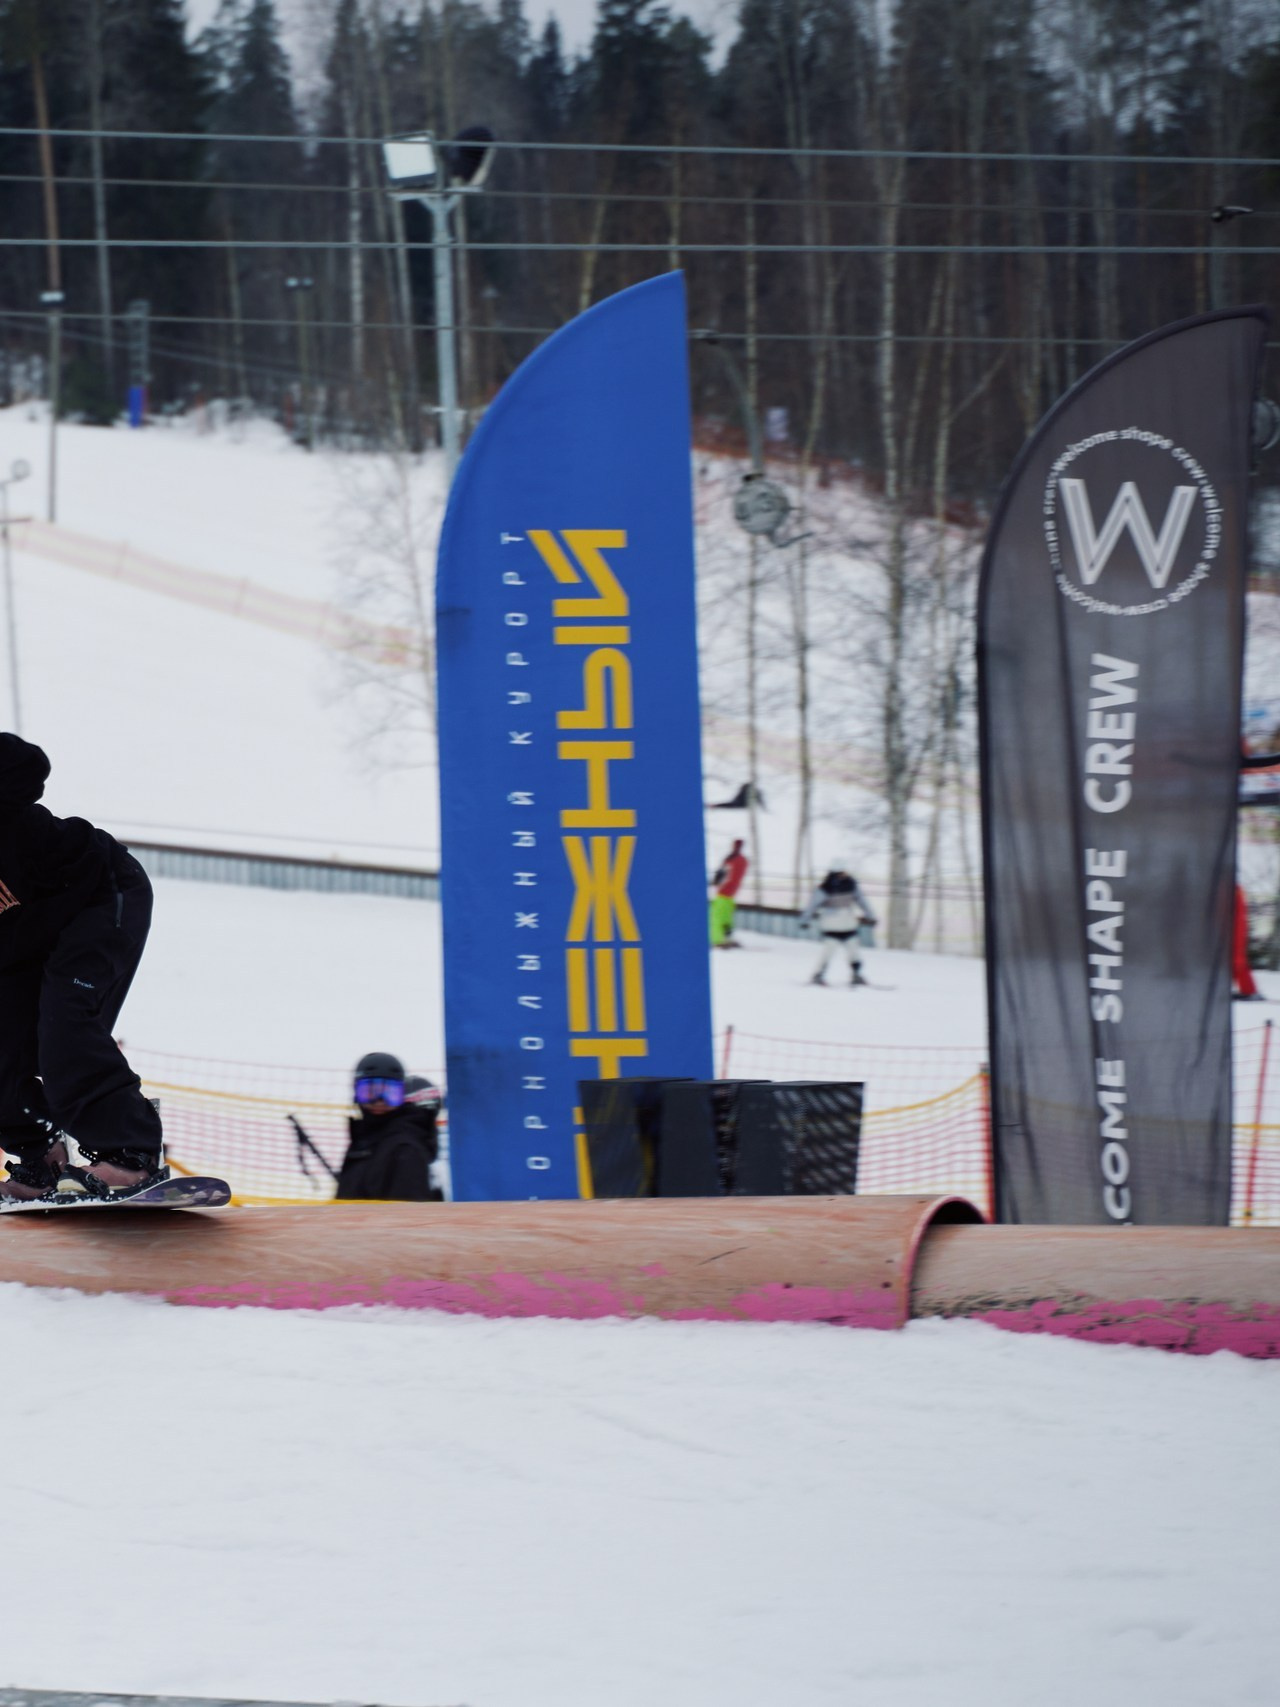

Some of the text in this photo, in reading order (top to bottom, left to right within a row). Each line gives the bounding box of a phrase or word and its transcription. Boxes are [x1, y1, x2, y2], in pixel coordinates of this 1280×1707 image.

[1059, 478, 1198, 588] W
[501, 532, 551, 1200] ОРНОЛЫЖНЫЙ КУРОРТ
[1083, 653, 1140, 1226] COME SHAPE CREW
